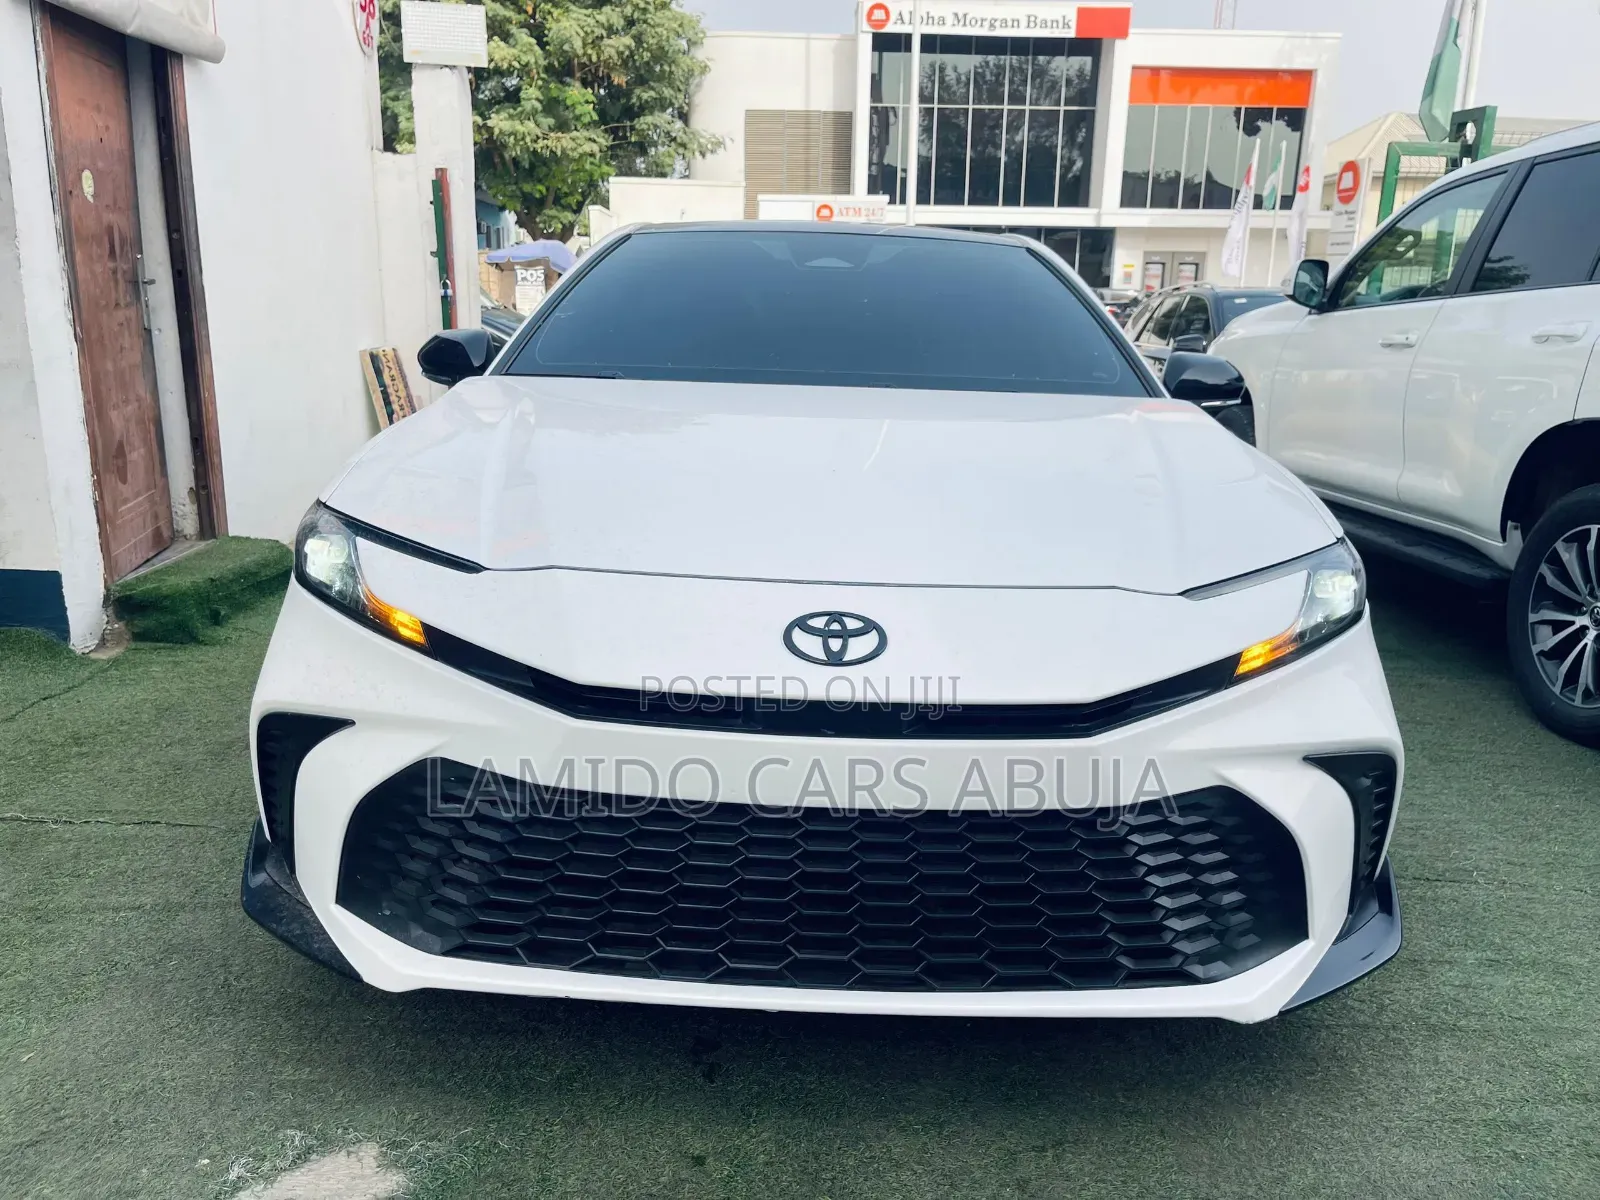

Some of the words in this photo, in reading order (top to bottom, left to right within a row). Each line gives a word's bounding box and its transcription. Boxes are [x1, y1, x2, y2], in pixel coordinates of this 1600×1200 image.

[952, 12, 1021, 32] Morgan
[1025, 14, 1072, 30] Bank
[838, 207, 862, 217] ATM
[516, 269, 545, 281] POS
